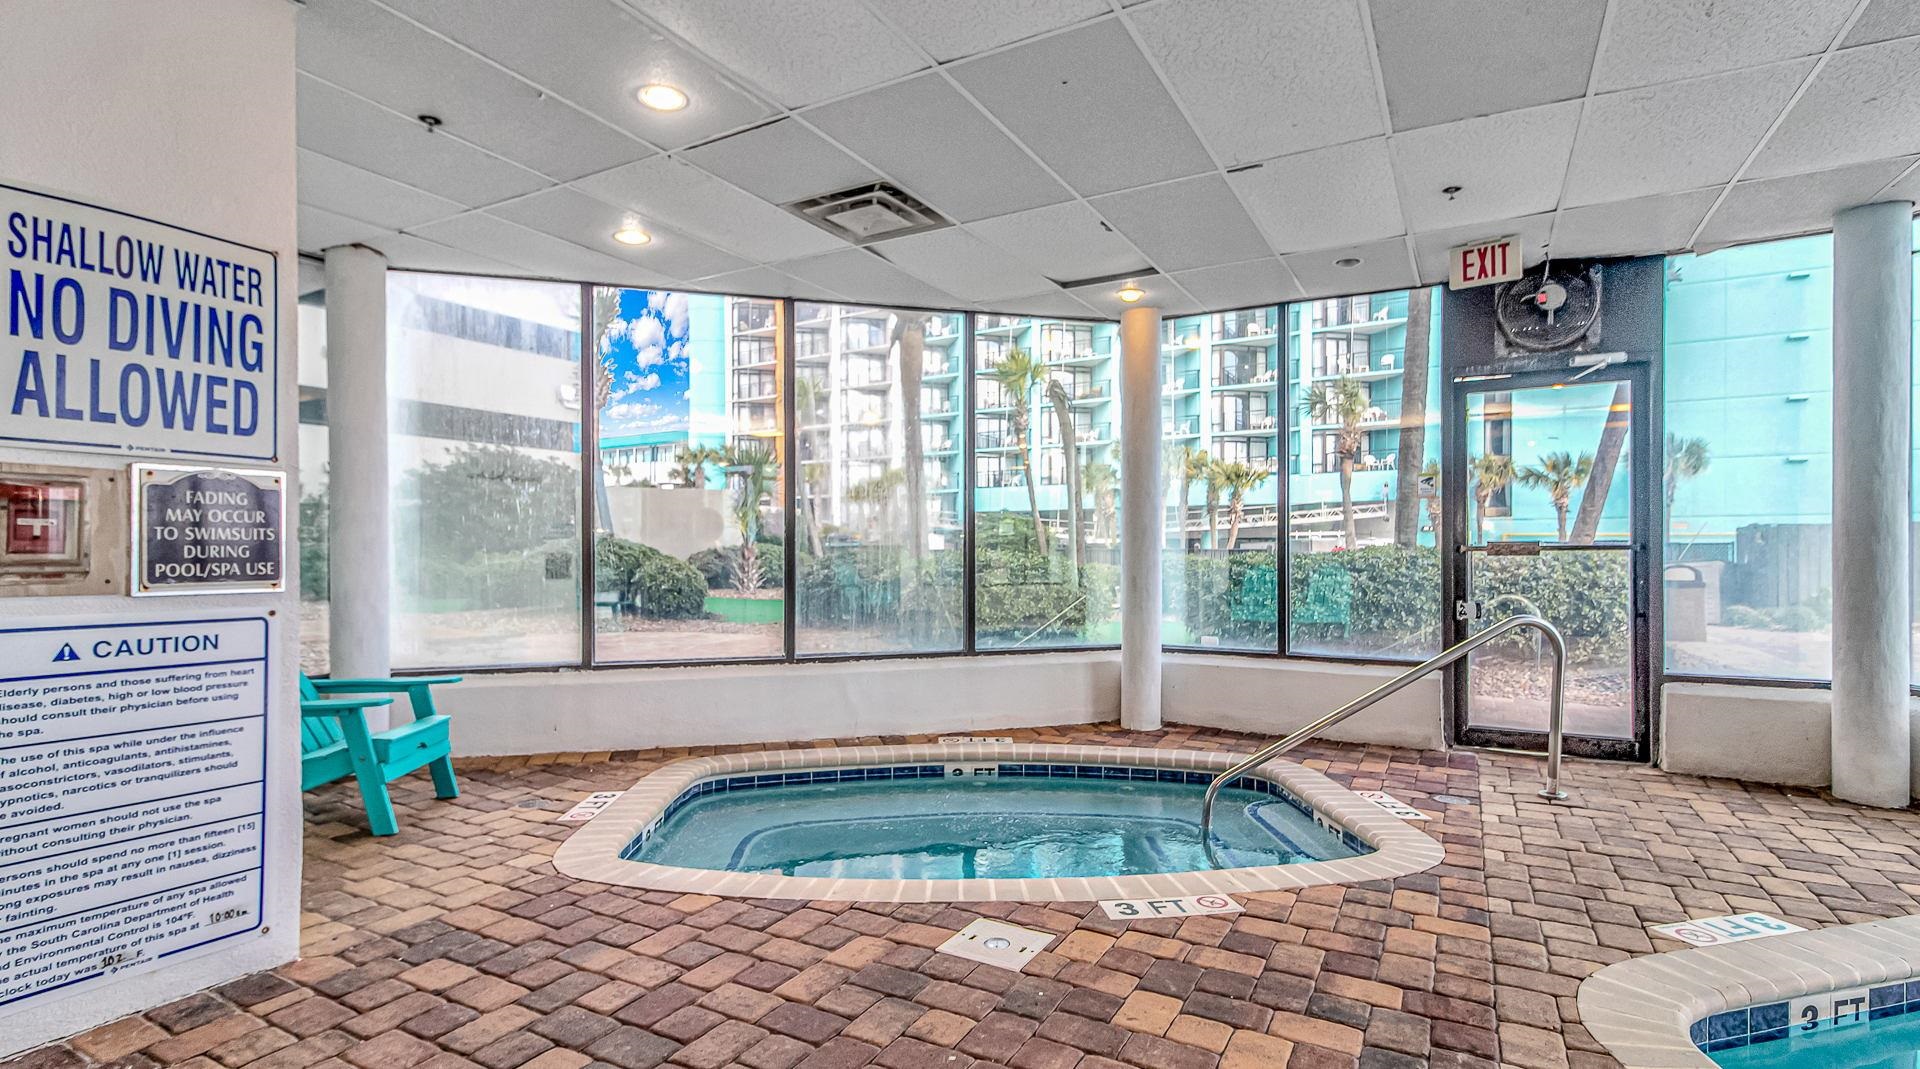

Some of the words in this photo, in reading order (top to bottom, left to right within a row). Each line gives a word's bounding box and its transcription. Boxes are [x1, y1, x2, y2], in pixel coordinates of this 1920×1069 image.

[8, 212, 164, 285] SHALLOW
[174, 248, 263, 306] WATER
[1462, 243, 1510, 282] EXIT
[9, 269, 84, 345] NO
[108, 287, 263, 372] DIVING
[11, 350, 258, 436] ALLOWED
[186, 490, 248, 506] FADING
[166, 508, 202, 522] MAY
[208, 509, 266, 523] OCCUR
[154, 526, 178, 540] TO
[184, 527, 275, 540] SWIMSUITS
[184, 545, 250, 558] DURING
[155, 562, 240, 578] POOL/SPA
[246, 562, 274, 576] USE
[92, 634, 218, 658] CAUTION
[43, 683, 92, 695] persons
[96, 680, 117, 689] and
[121, 678, 151, 686] those
[155, 674, 201, 683] suffering
[231, 668, 254, 676] heart
[108, 691, 133, 701] high
[174, 685, 202, 693] blood
[206, 681, 248, 691] pressure
[0, 714, 38, 724] hould
[42, 709, 87, 720] consult
[91, 706, 117, 715] their
[120, 700, 172, 713] physician
[176, 696, 208, 705] before
[212, 693, 239, 702] using
[0, 756, 16, 765] he
[21, 754, 43, 762] use
[48, 750, 60, 759] of
[63, 747, 85, 756] this
[89, 744, 110, 753] spa
[113, 740, 142, 749] while
[146, 735, 177, 745] under
[200, 726, 244, 737] influence
[18, 728, 44, 737] spa.
[0, 772, 100, 792] asoconstrictors,
[0, 792, 58, 808] ypnotics,
[63, 782, 117, 796] narcotics
[136, 767, 201, 784] tranquilizers
[205, 761, 238, 772] should
[974, 768, 995, 776] FT
[0, 828, 48, 843] regnant
[53, 820, 96, 833] women
[100, 811, 139, 824] should
[142, 808, 160, 816] not
[163, 804, 181, 812] use
[185, 800, 200, 808] the
[204, 796, 222, 805] spa
[11, 802, 64, 818] avoided.
[0, 844, 38, 856] ithout
[42, 830, 106, 849] consulting
[110, 824, 136, 835] their
[138, 814, 192, 831] physician.
[0, 869, 42, 883] ersons
[47, 858, 88, 873] should
[92, 850, 127, 864] spend
[148, 841, 175, 850] more
[179, 835, 201, 844] than
[204, 827, 234, 838] fifteen
[0, 883, 40, 896] inutes
[60, 873, 78, 883] the
[82, 868, 104, 880] spa
[107, 864, 118, 872] at
[121, 860, 141, 870] any
[144, 855, 164, 864] one
[184, 841, 226, 855] session.
[0, 900, 21, 910] ong
[26, 885, 90, 904] exposures
[94, 878, 118, 888] may
[121, 867, 153, 881] result
[212, 845, 256, 860] dizziness
[6, 906, 57, 922] fainting.
[7, 946, 26, 956] the
[31, 934, 68, 950] South
[72, 921, 120, 939] Carolina
[124, 902, 187, 925] Department
[190, 898, 200, 907] of
[203, 890, 235, 903] Health
[16, 920, 77, 940] maximum
[80, 902, 149, 924] temperature
[153, 896, 164, 905] of
[166, 891, 186, 901] any
[188, 886, 207, 896] spa
[210, 875, 247, 890] allowed
[1115, 902, 1139, 916] 3
[1148, 900, 1187, 914] FT
[1744, 916, 1787, 931] 3
[15, 936, 104, 966] Environmental
[108, 922, 149, 941] Control
[1704, 919, 1761, 938] FT
[14, 963, 52, 980] actual
[57, 944, 127, 968] temperature
[131, 938, 142, 947] of
[145, 933, 165, 943] this
[168, 927, 187, 937] spa
[0, 983, 31, 998] clock
[36, 972, 70, 987] today
[74, 965, 98, 976] was
[1801, 1004, 1819, 1031] 3
[1833, 996, 1866, 1026] FT
